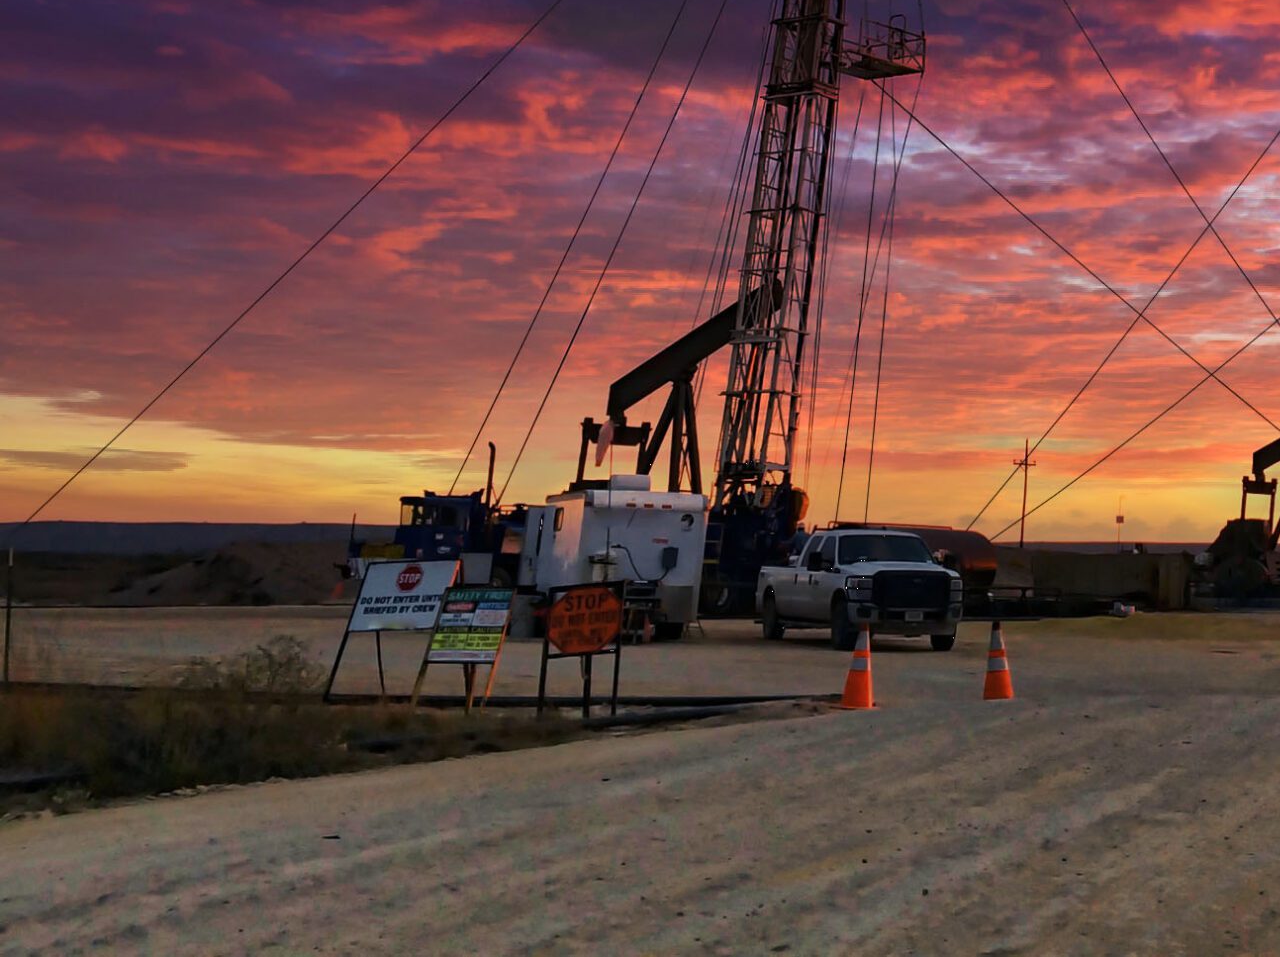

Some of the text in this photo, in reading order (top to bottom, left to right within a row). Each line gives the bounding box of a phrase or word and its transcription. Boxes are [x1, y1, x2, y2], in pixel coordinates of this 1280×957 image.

[399, 573, 421, 583] STOP
[361, 596, 373, 604] DO
[374, 596, 392, 604] NOT
[393, 595, 420, 603] ENTER
[447, 591, 481, 600] SAFETY
[565, 593, 608, 612] STOP
[363, 604, 436, 614] BRIEFED BY CREW
